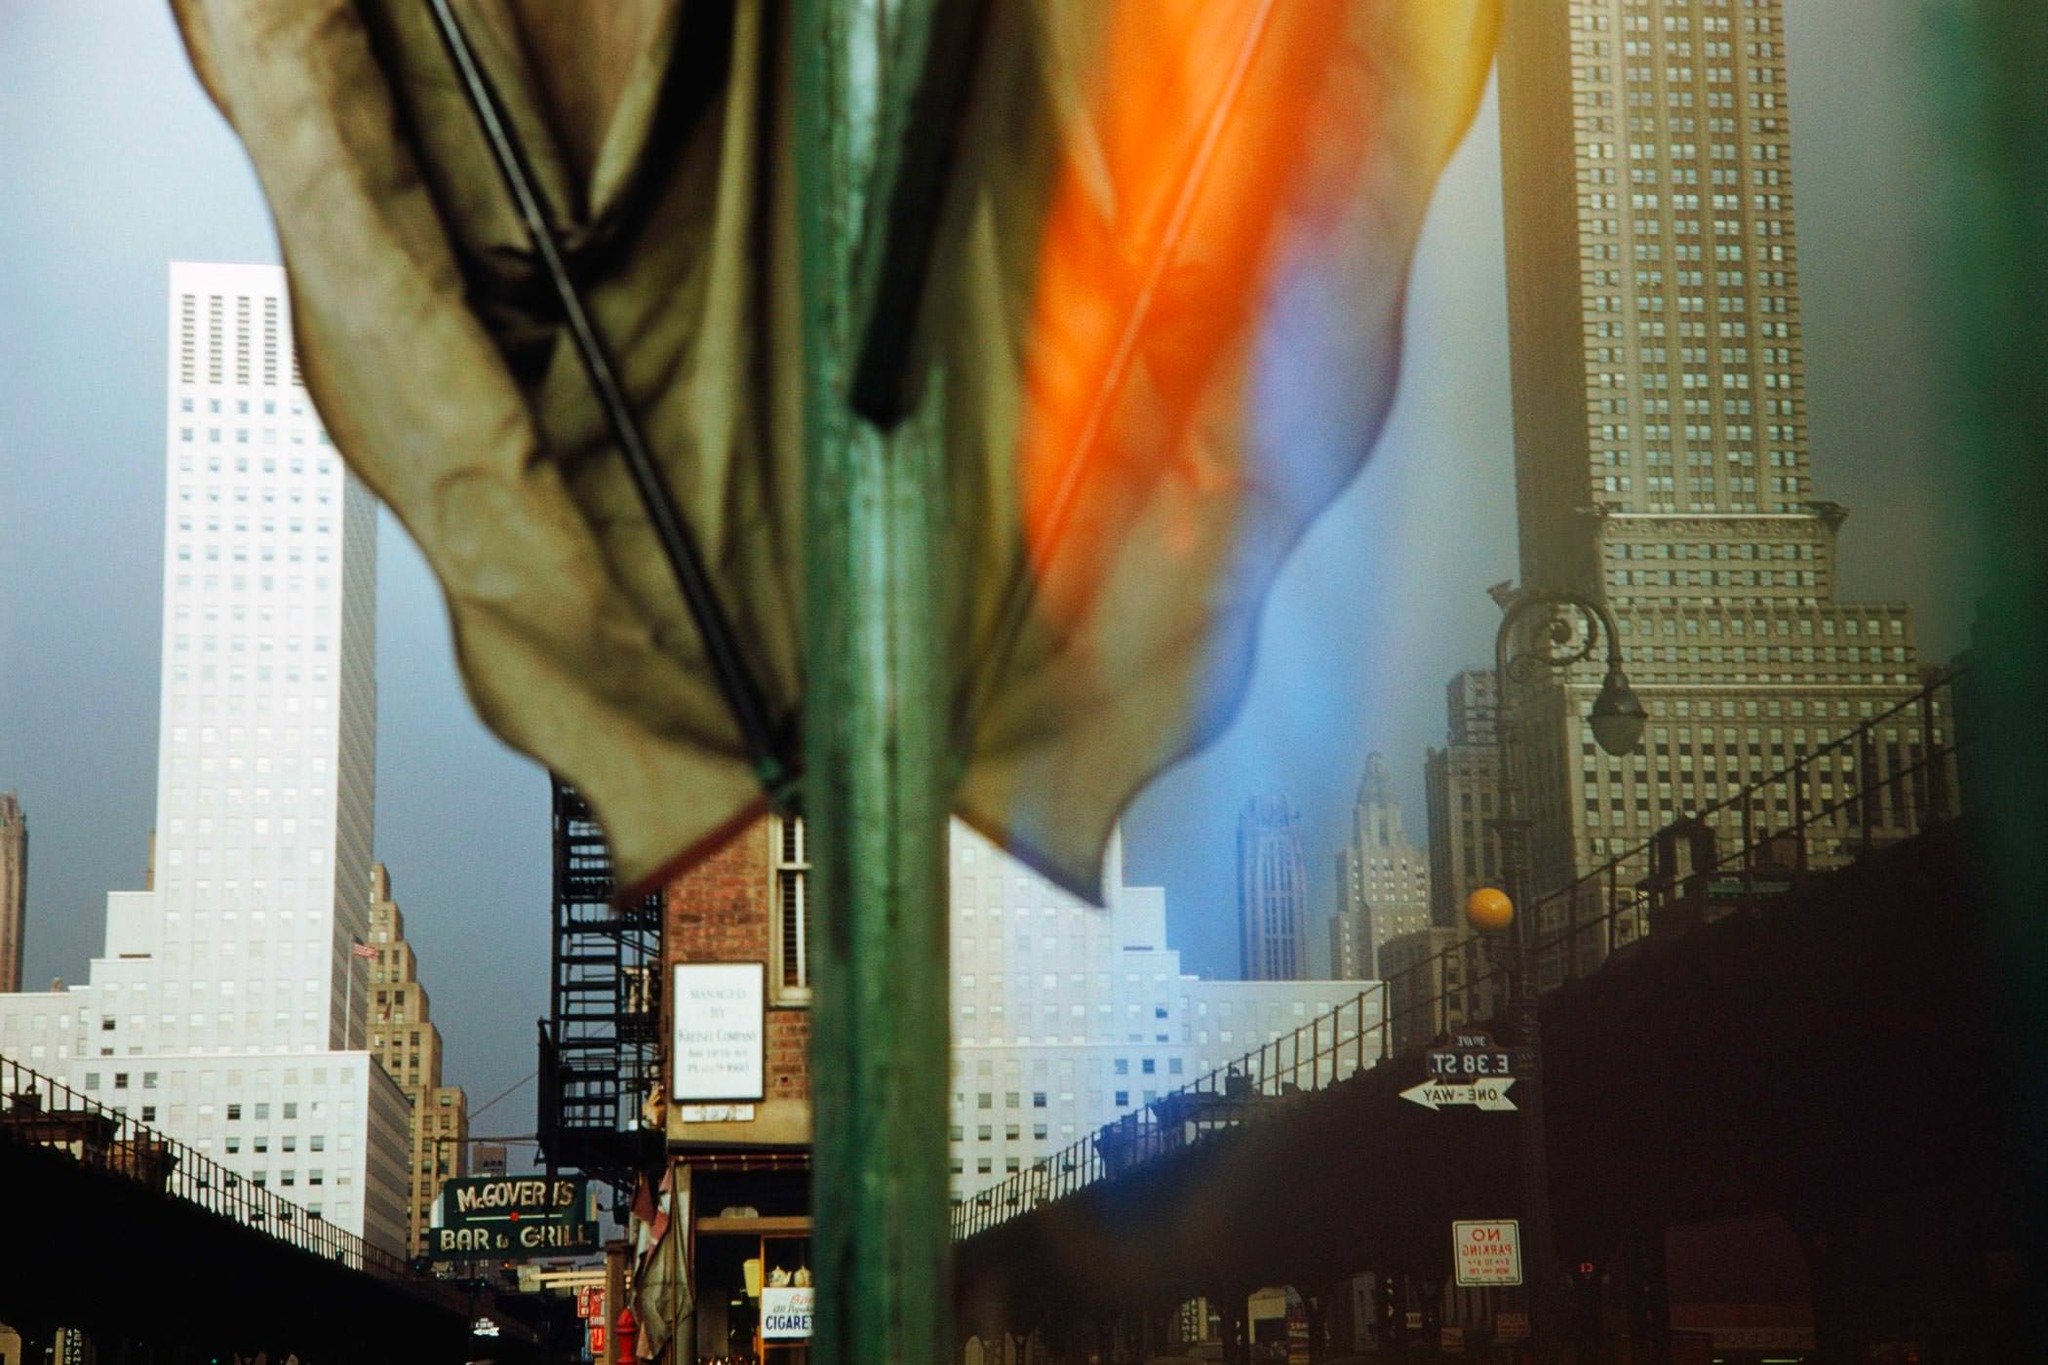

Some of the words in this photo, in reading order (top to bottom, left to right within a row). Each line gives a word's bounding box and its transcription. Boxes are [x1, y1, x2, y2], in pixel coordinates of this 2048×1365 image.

[440, 1228, 490, 1251] BAR
[496, 1234, 510, 1249] &
[519, 1224, 593, 1248] GRILL
